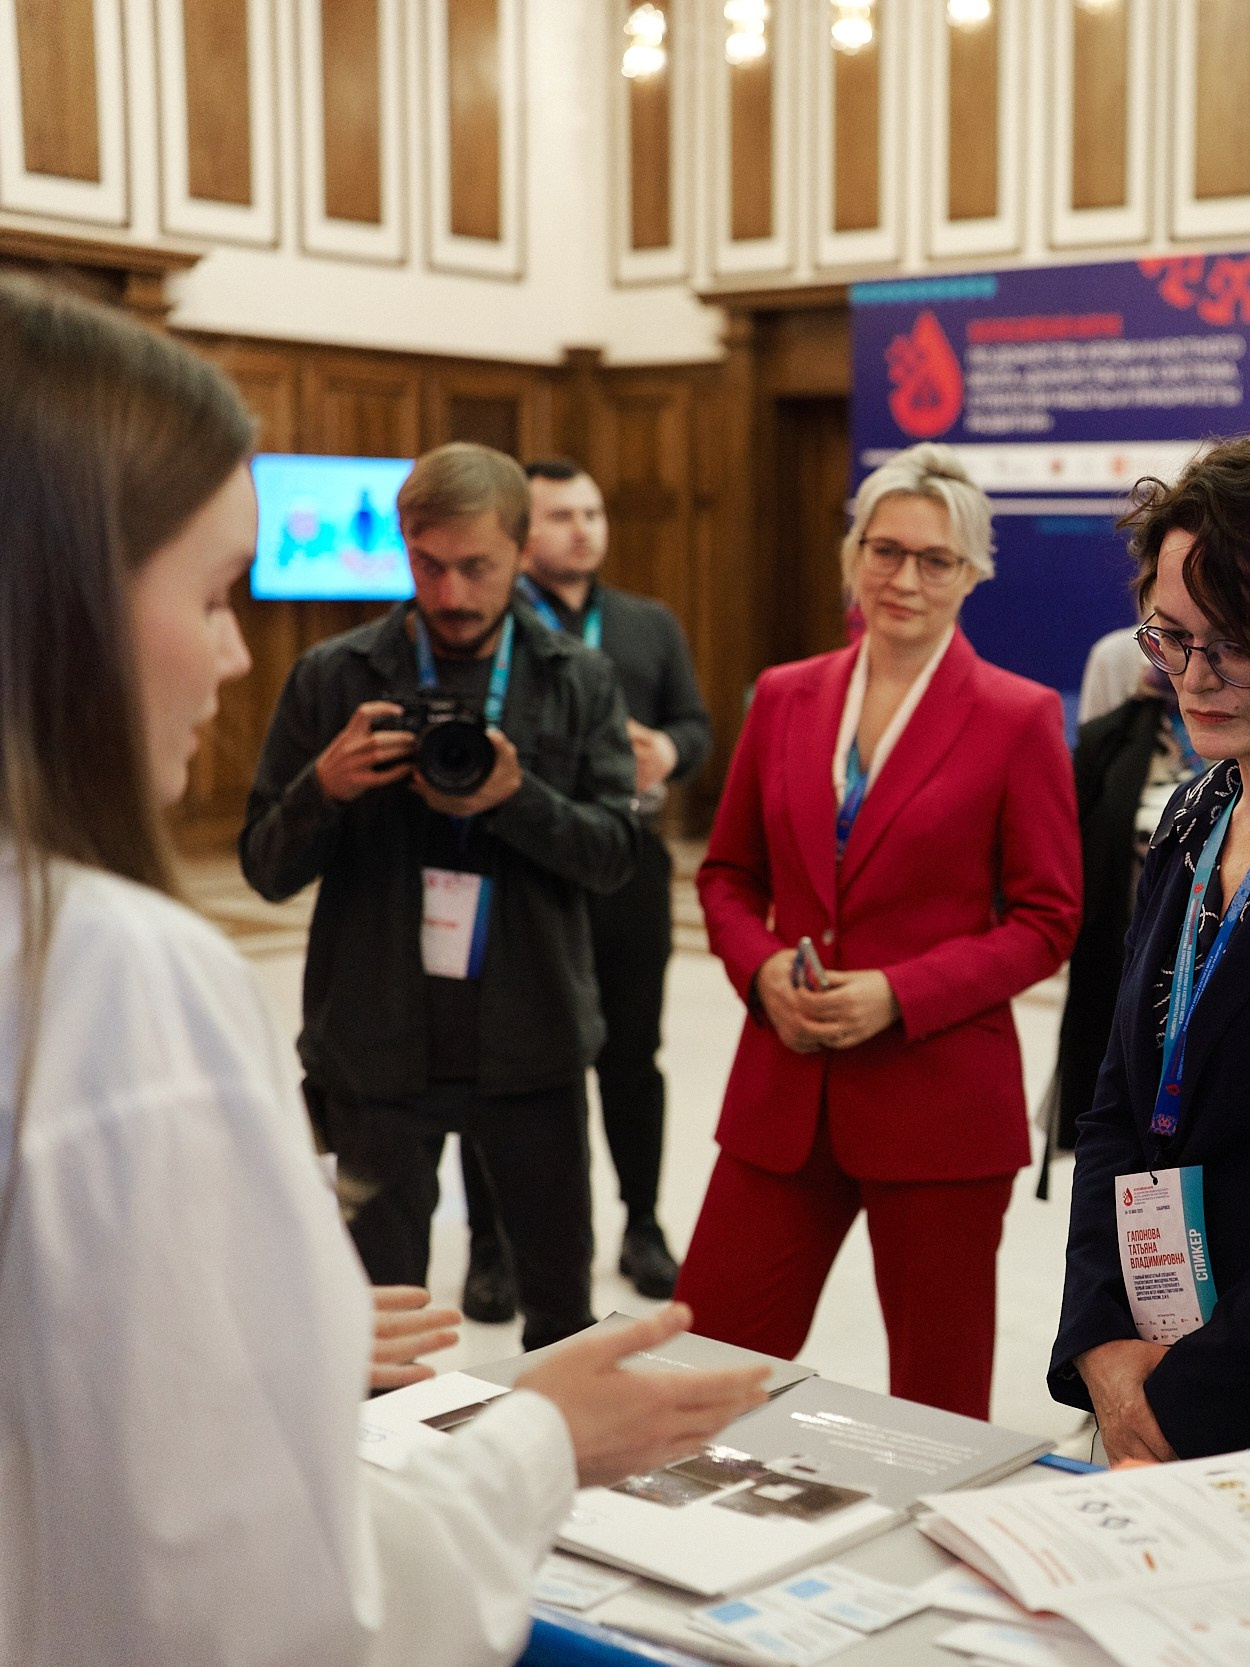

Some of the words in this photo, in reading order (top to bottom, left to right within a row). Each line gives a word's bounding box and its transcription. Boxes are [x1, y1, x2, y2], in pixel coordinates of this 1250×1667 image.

[1126, 1227, 1161, 1243] ГАПОНОВА
[1128, 1242, 1158, 1256] ТАТЬЯНА
[1188, 1228, 1209, 1281] СПИКЕР
[1130, 1252, 1186, 1269] ВЛАДИМИРОВНА
